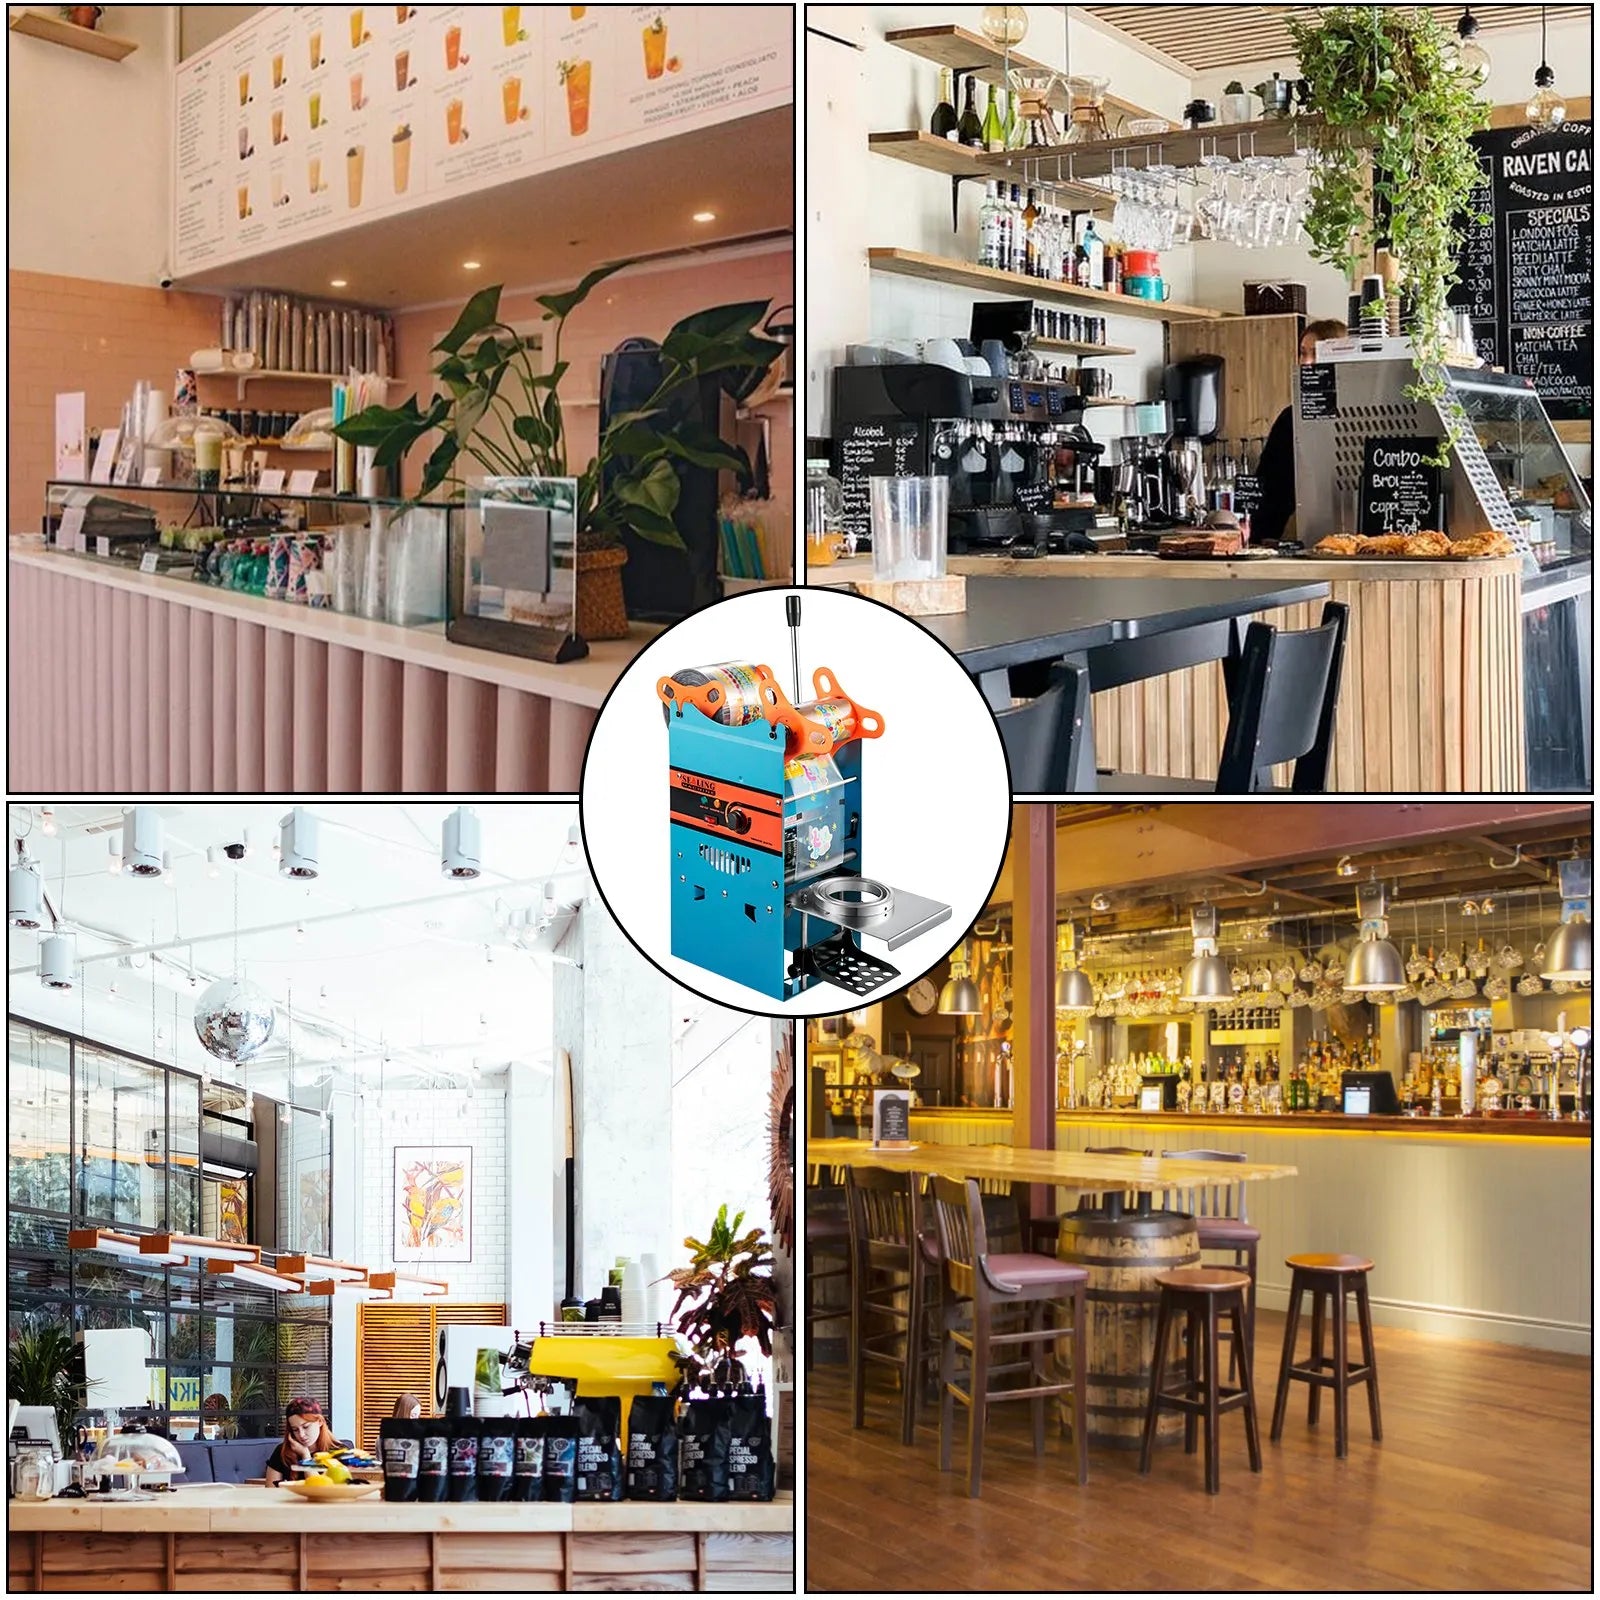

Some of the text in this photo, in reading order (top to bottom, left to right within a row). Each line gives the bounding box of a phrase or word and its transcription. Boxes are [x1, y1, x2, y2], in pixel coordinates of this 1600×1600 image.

[1503, 148, 1591, 178] RAVEN CA
[1509, 181, 1549, 201] ROASTED
[1553, 192, 1564, 200] IN
[1527, 206, 1591, 226] SPECIALS
[1512, 224, 1579, 240] LONDON FOG
[1512, 237, 1580, 253] MATCHA LATTE
[1544, 250, 1576, 263] LATTE
[1476, 266, 1485, 279] 3
[1541, 263, 1564, 276] CHAI
[1475, 291, 1483, 304] 6
[1523, 324, 1586, 340] NON-COFFEE
[1515, 338, 1578, 353] MATCHA TEA
[1515, 353, 1539, 364] CHAI
[853, 425, 885, 437] Alcohol
[1373, 448, 1420, 467] Combo
[578, 1453, 609, 1462] ESPRESSO
